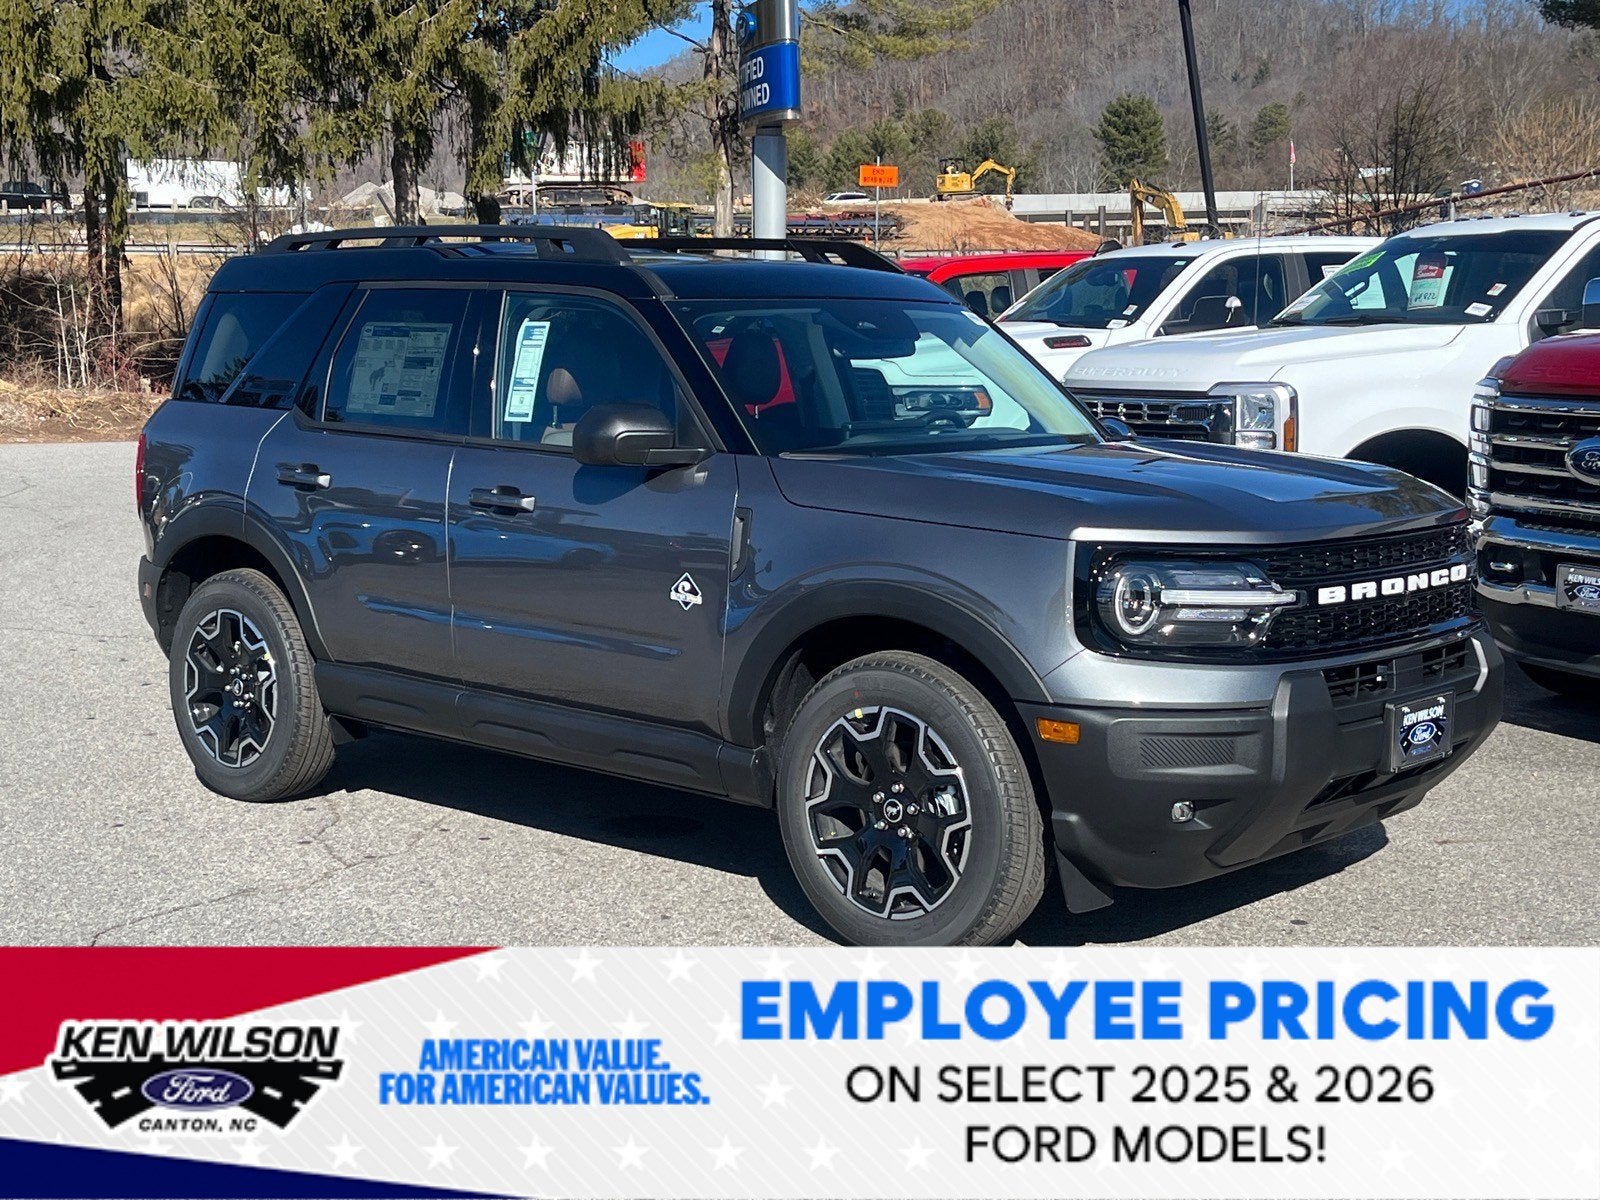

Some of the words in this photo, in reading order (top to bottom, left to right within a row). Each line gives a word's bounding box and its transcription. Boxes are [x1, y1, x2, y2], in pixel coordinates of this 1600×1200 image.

[1318, 564, 1467, 605] BRONCO
[1568, 574, 1584, 583] KEN
[1403, 712, 1418, 727] KEN
[1417, 704, 1445, 722] WILSON
[1413, 725, 1432, 742] Ford
